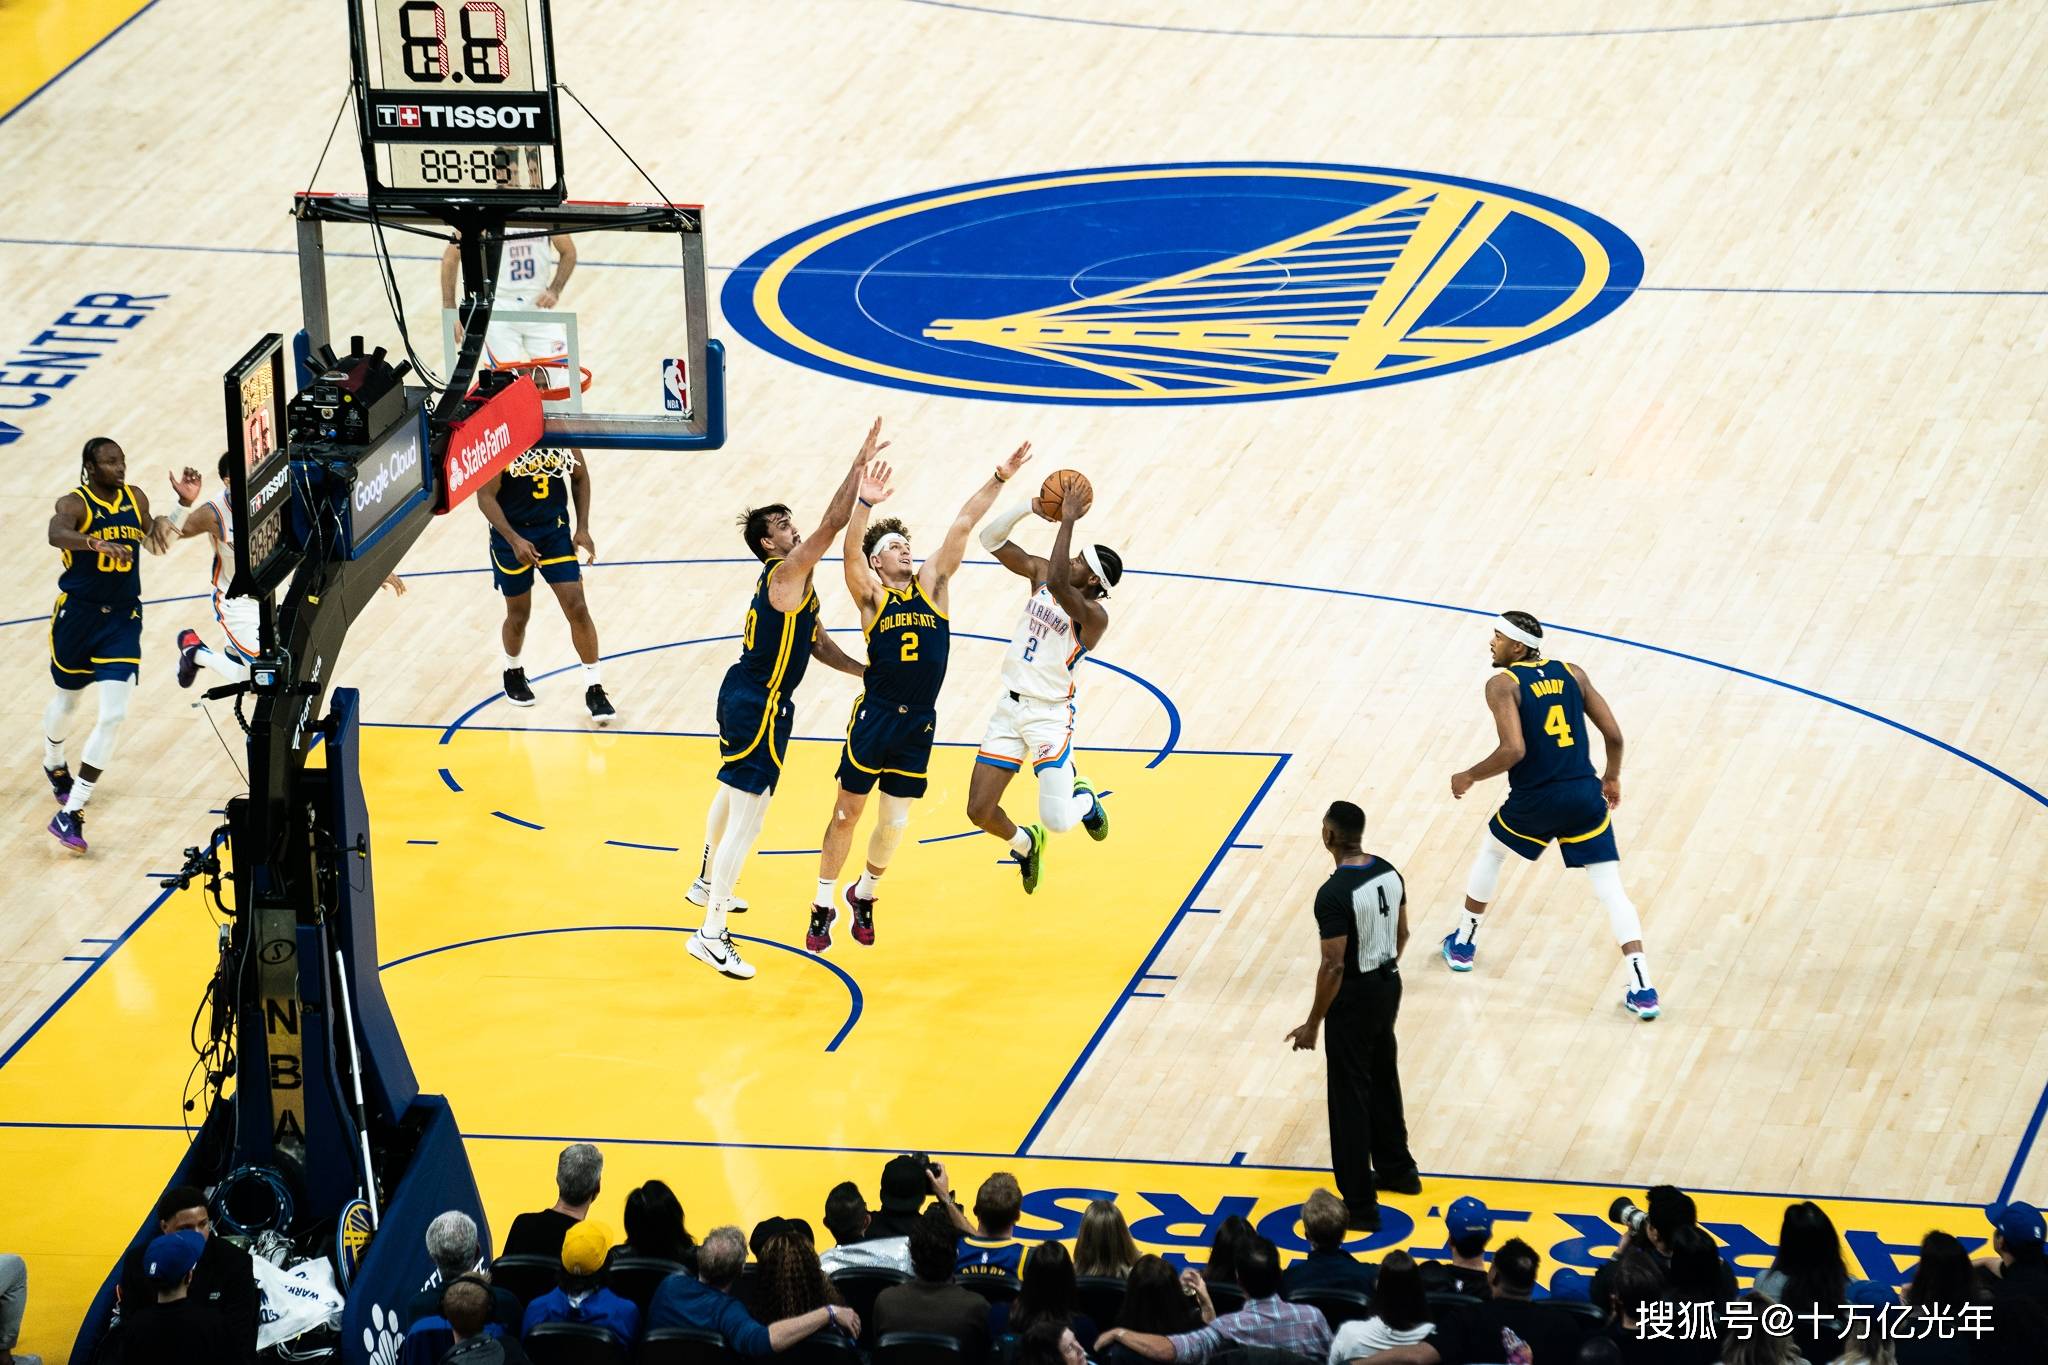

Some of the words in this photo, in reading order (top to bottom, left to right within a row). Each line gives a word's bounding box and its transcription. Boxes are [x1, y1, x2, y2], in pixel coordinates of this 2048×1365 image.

[422, 106, 541, 128] TISSOT
[510, 259, 535, 281] 29
[667, 399, 680, 409] NBA
[261, 465, 289, 505] TISSOT
[355, 463, 389, 511] Google
[390, 436, 417, 482] Cloud
[532, 474, 549, 499] 3
[743, 607, 758, 650] 0
[880, 612, 912, 633] GOLDEN
[901, 632, 919, 661] 2
[1023, 635, 1038, 662] 2
[301, 655, 322, 732] Fanics
[1544, 704, 1575, 748] 4
[1377, 885, 1390, 918] 4
[265, 998, 306, 1145] NBA
